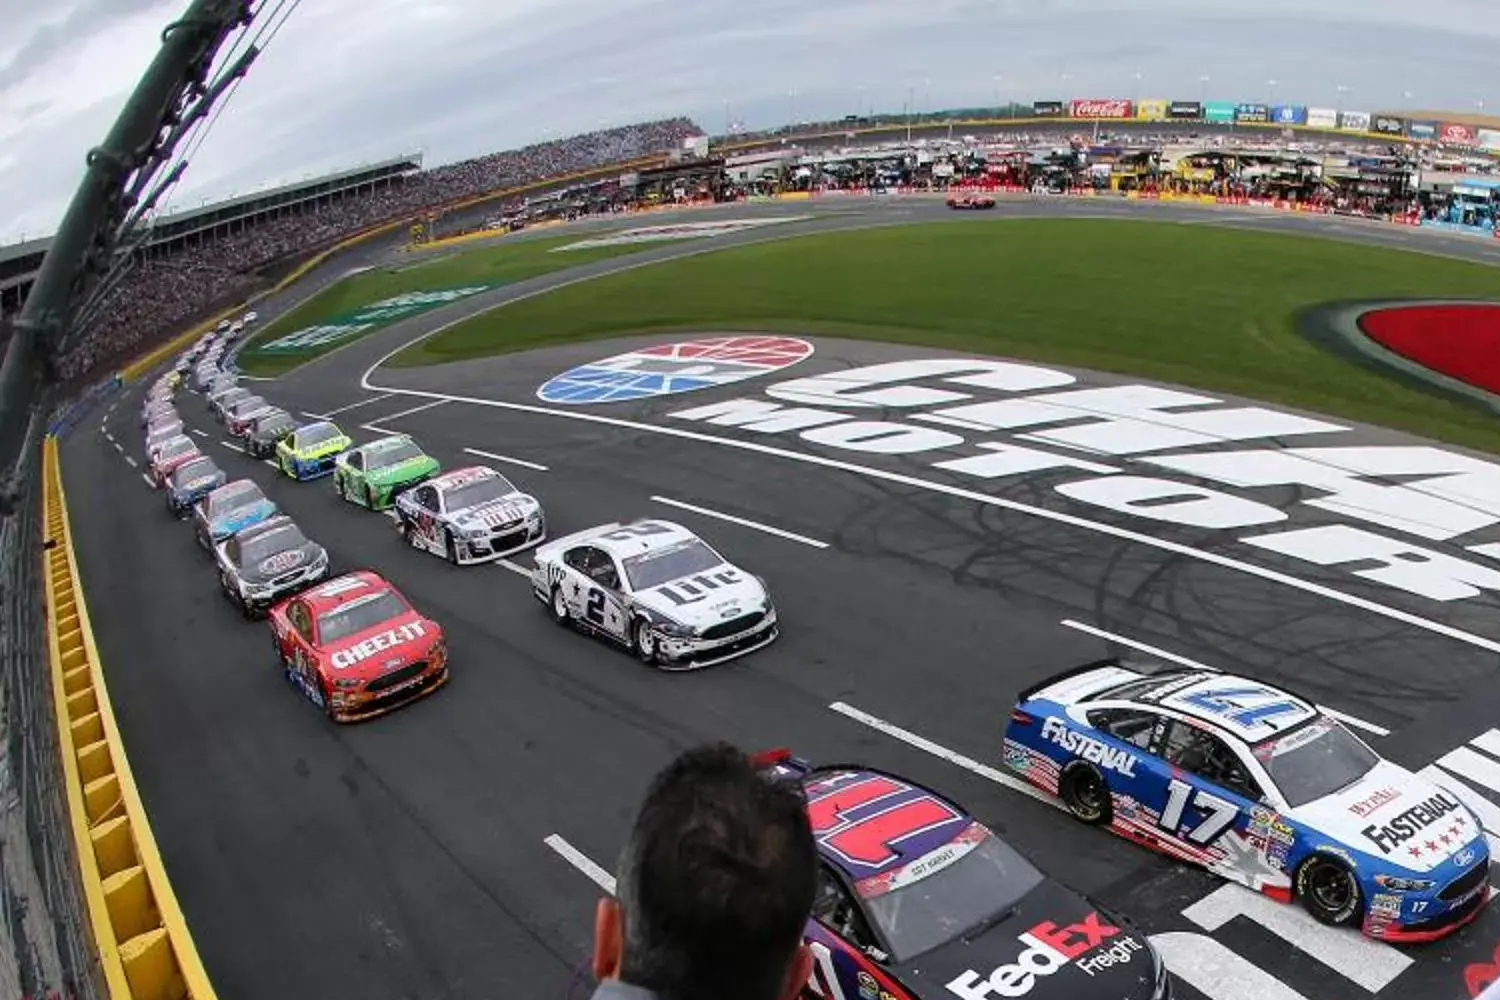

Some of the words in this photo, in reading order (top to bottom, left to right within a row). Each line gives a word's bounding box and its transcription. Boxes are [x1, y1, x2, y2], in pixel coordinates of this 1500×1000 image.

[587, 588, 606, 625] 2
[331, 619, 425, 670] CHEEZ-IT
[1041, 716, 1138, 779] FASTENAL
[1157, 780, 1240, 846] 17
[1361, 792, 1460, 856] FASTENAL
[1410, 900, 1429, 914] 17
[1076, 936, 1143, 976] Freight
